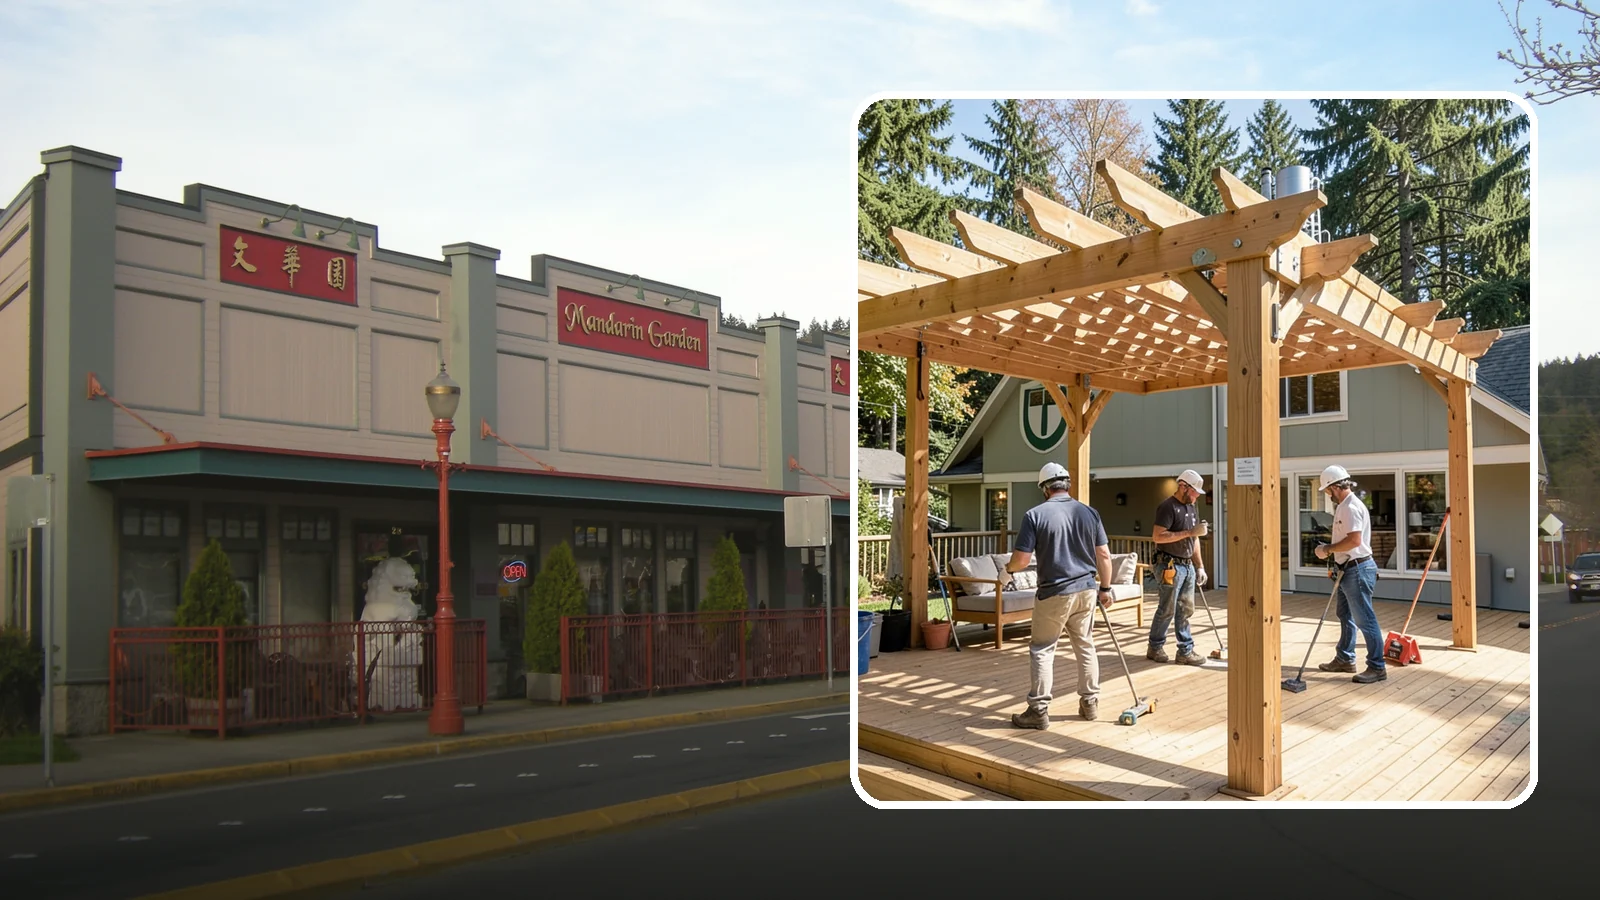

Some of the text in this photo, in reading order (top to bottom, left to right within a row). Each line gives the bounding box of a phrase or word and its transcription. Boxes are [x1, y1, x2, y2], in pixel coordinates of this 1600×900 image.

[564, 303, 701, 352] Mandarin Garden
[504, 567, 526, 578] OPEN
